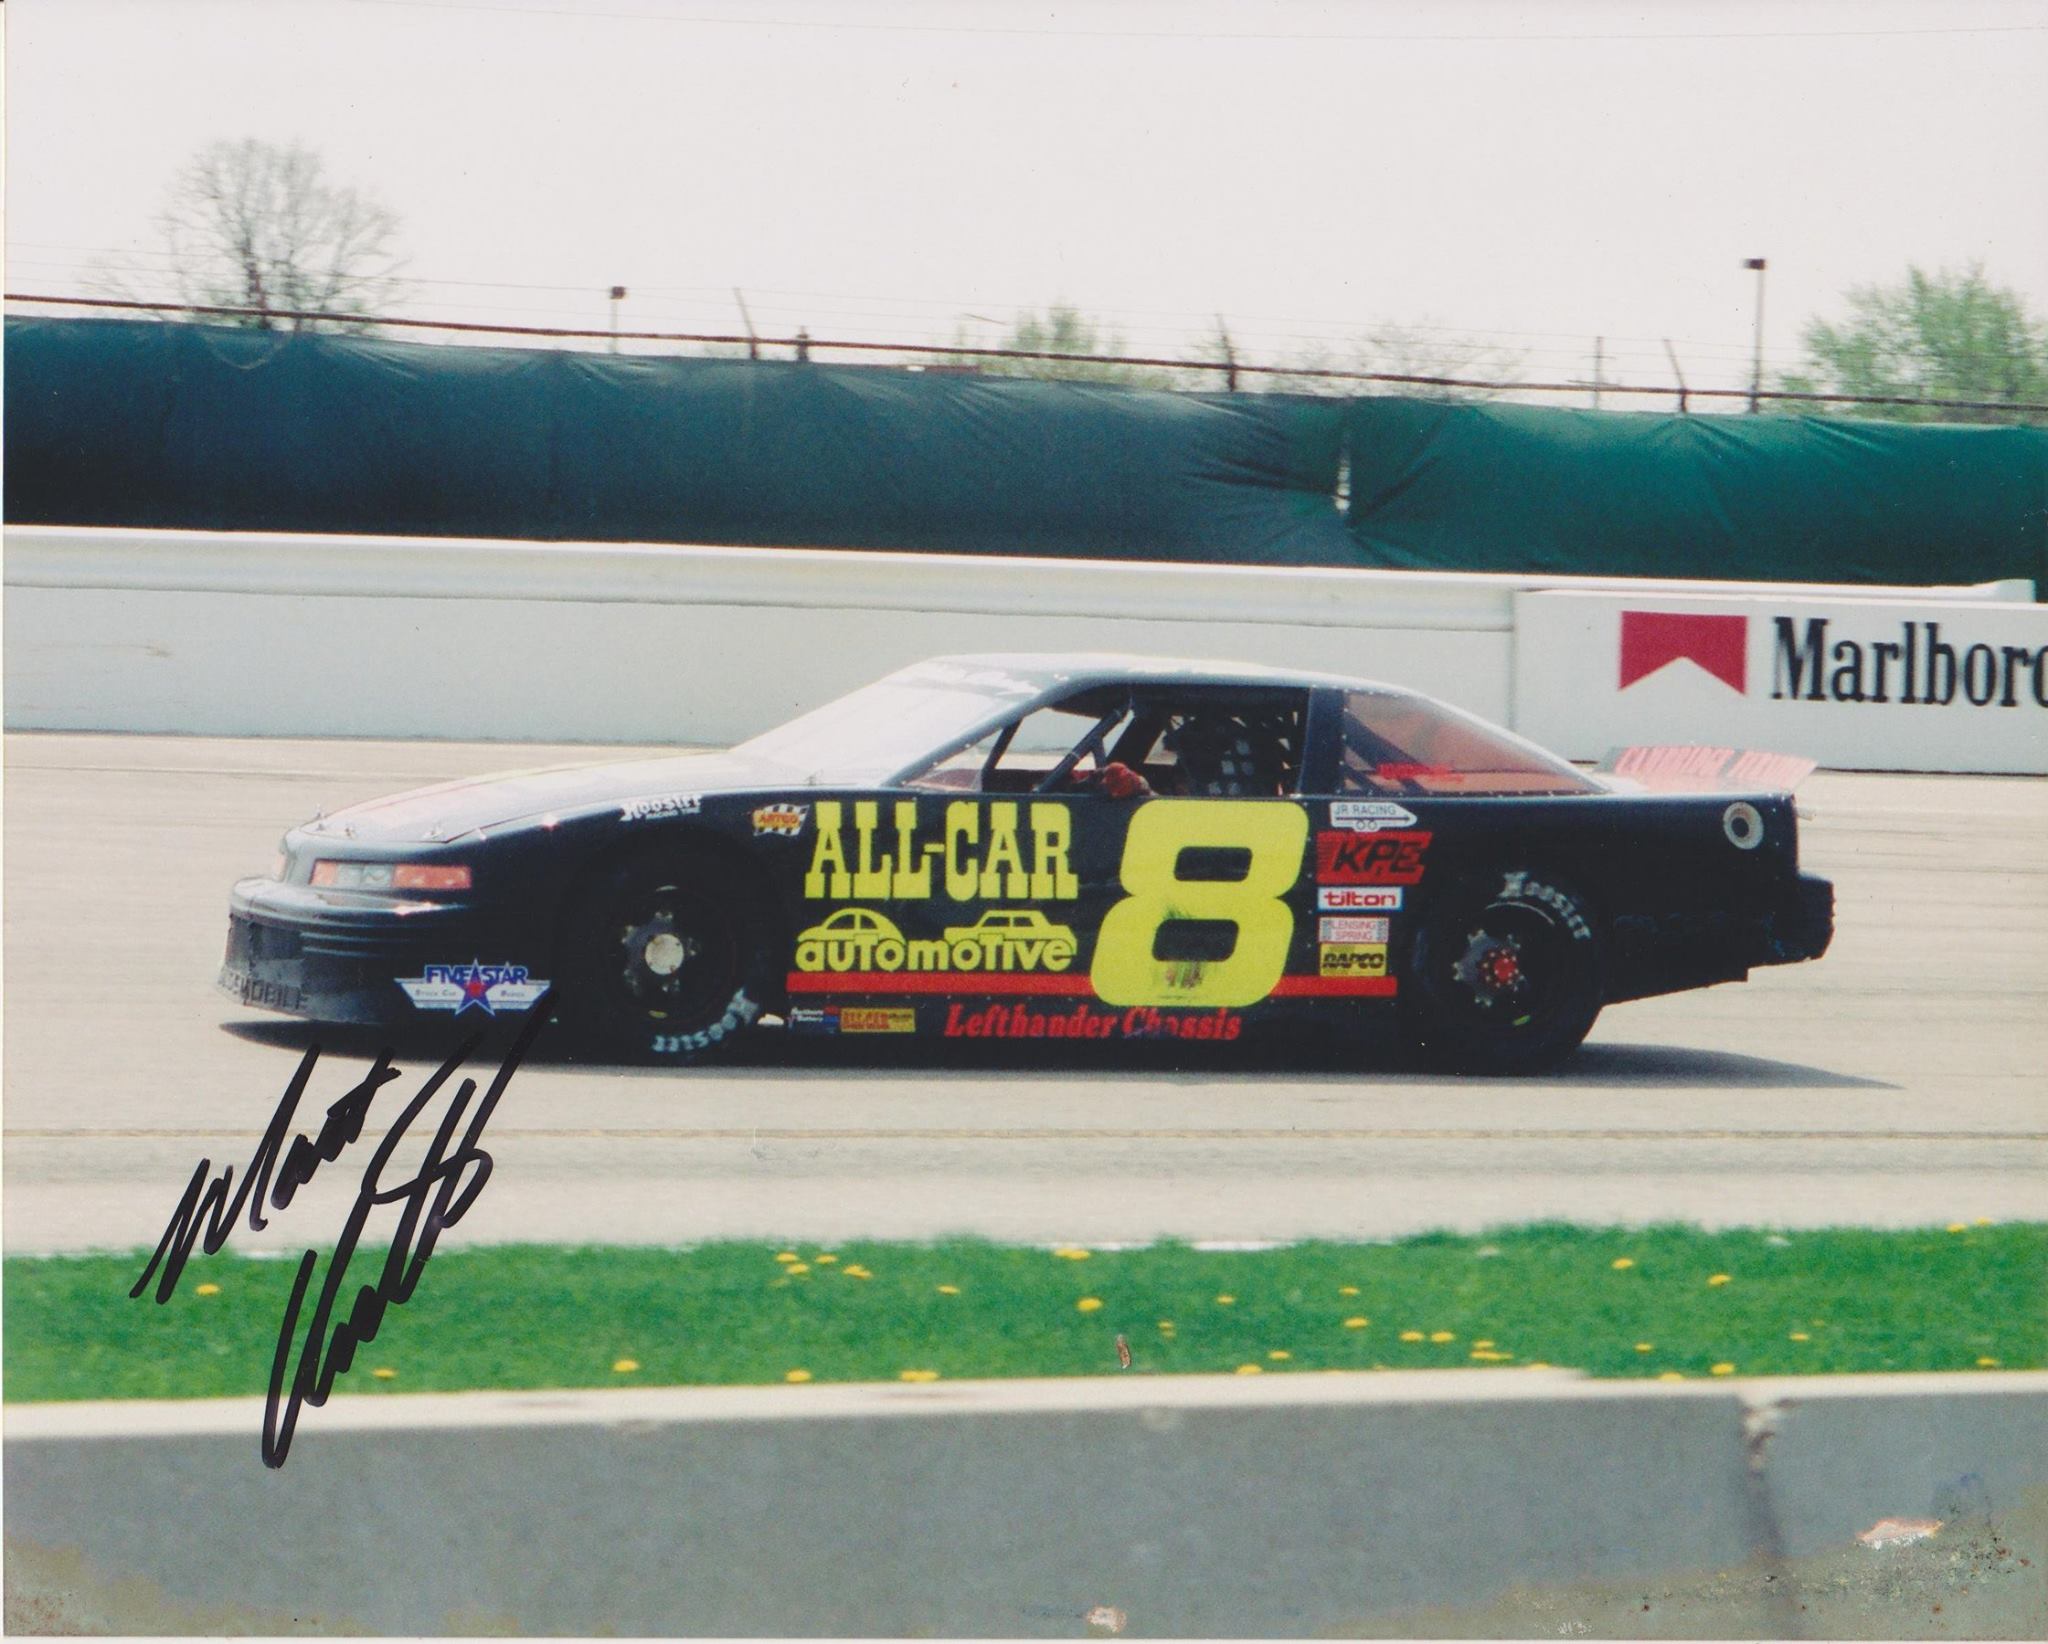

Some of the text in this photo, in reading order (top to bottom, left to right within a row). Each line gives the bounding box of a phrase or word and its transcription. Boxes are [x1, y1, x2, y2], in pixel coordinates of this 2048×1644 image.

[1334, 804, 1397, 815] JR RACING
[804, 801, 1079, 901] ALL-CAR
[1090, 800, 1309, 1007] 8
[1324, 891, 1397, 906] tilton
[425, 964, 528, 985] FIVE STAR
[944, 1003, 1118, 1038] Lefthander
